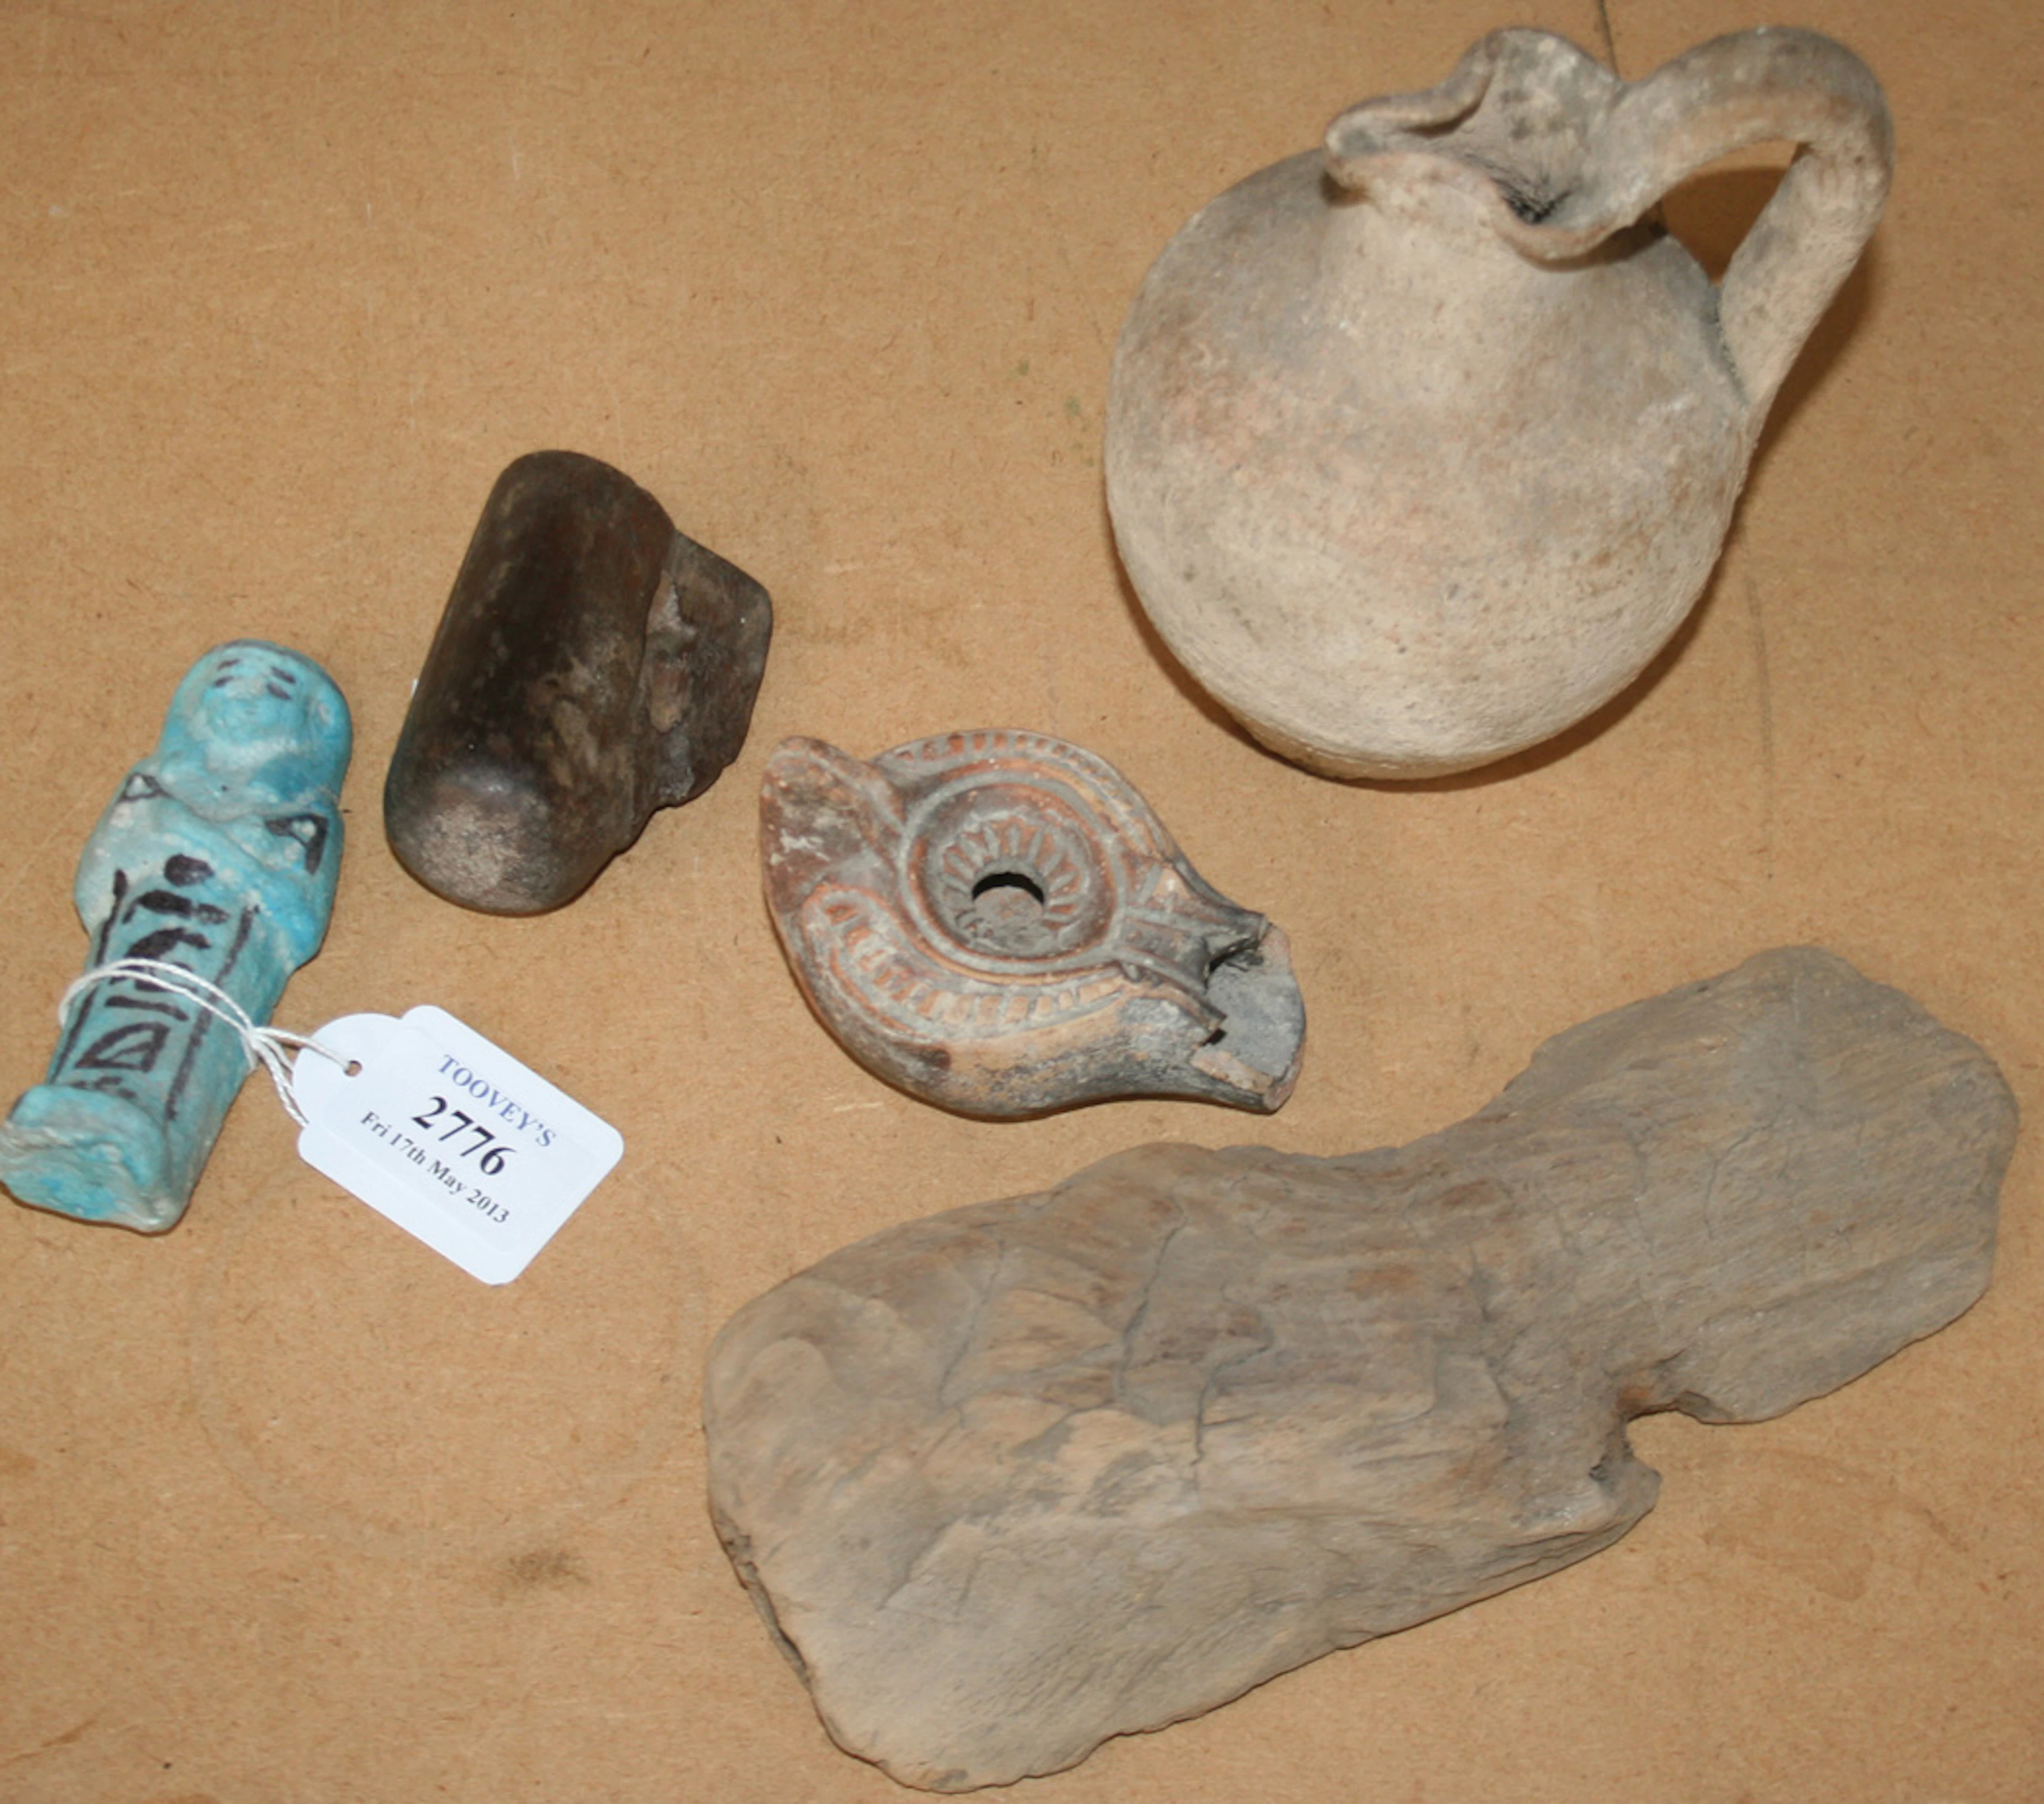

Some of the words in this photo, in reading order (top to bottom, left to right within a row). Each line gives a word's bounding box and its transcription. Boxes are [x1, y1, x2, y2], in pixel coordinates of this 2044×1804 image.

[411, 1095, 517, 1176] 2776
[438, 1054, 557, 1148] TOOVEY'S
[360, 1111, 391, 1138] Fri
[390, 1133, 426, 1166] 17th
[427, 1161, 467, 1195] May
[467, 1190, 510, 1223] 2013
